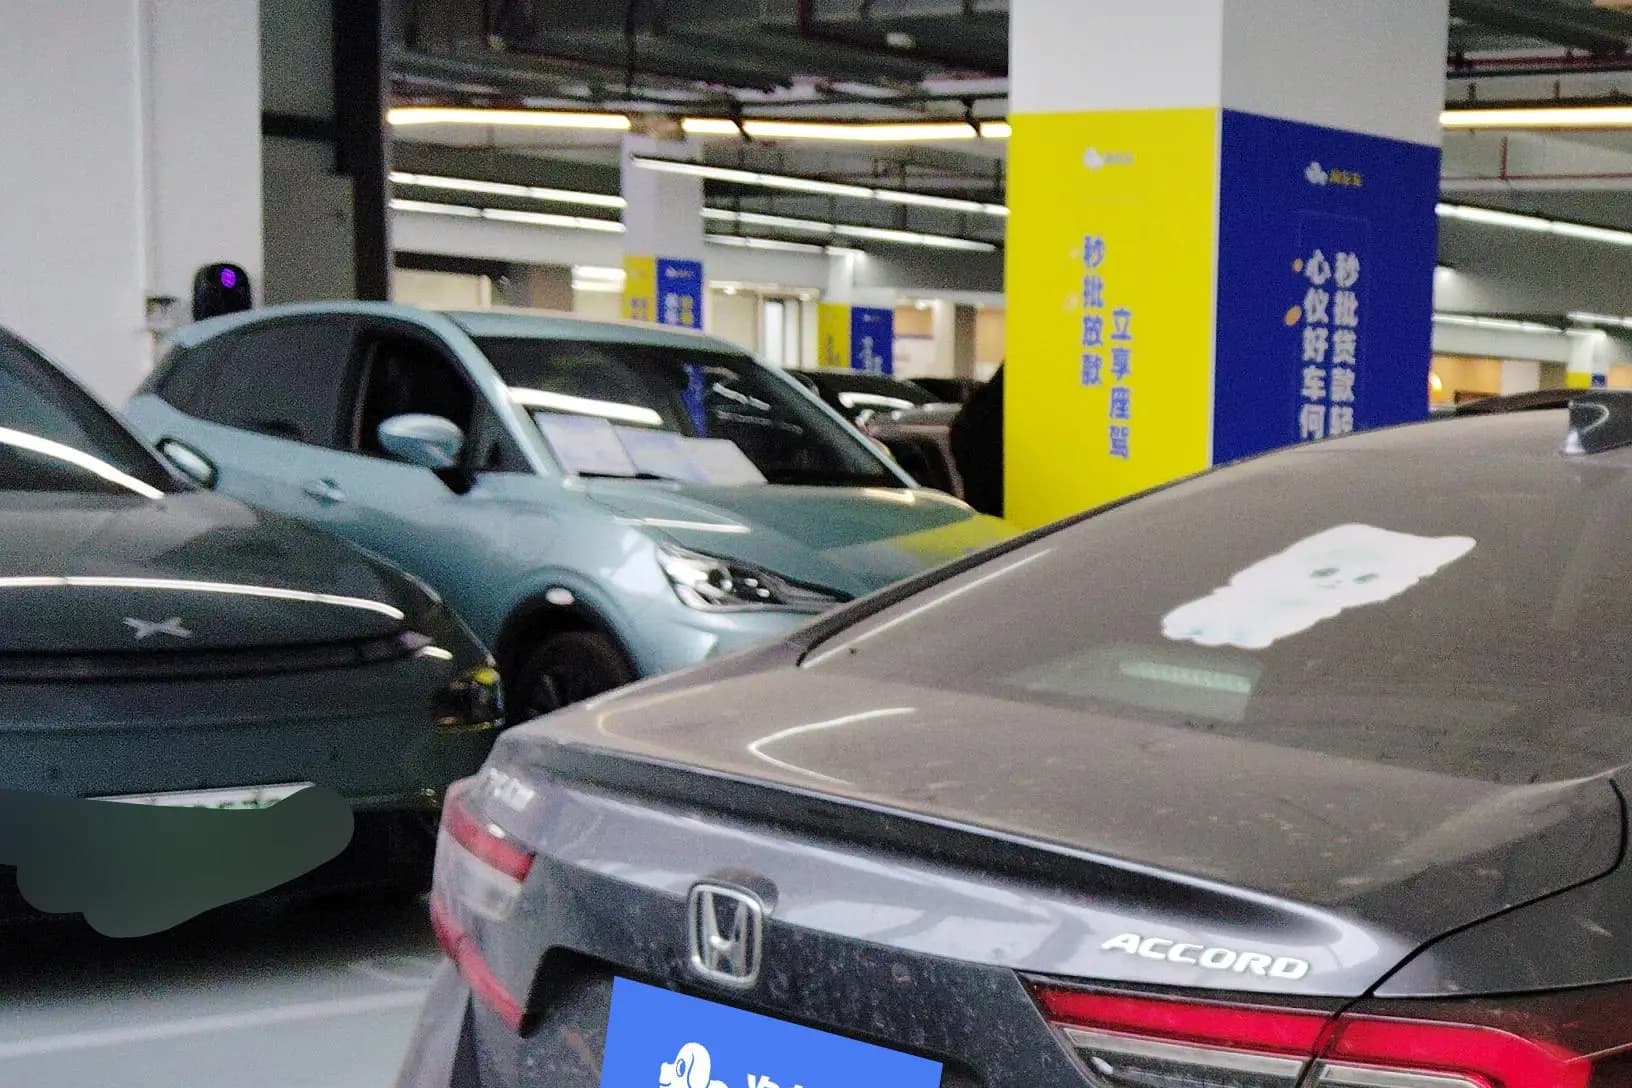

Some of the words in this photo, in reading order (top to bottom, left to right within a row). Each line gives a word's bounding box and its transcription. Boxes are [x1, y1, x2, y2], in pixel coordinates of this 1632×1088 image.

[1082, 236, 1104, 385] 秒批放款
[1101, 932, 1310, 981] ACCORD
